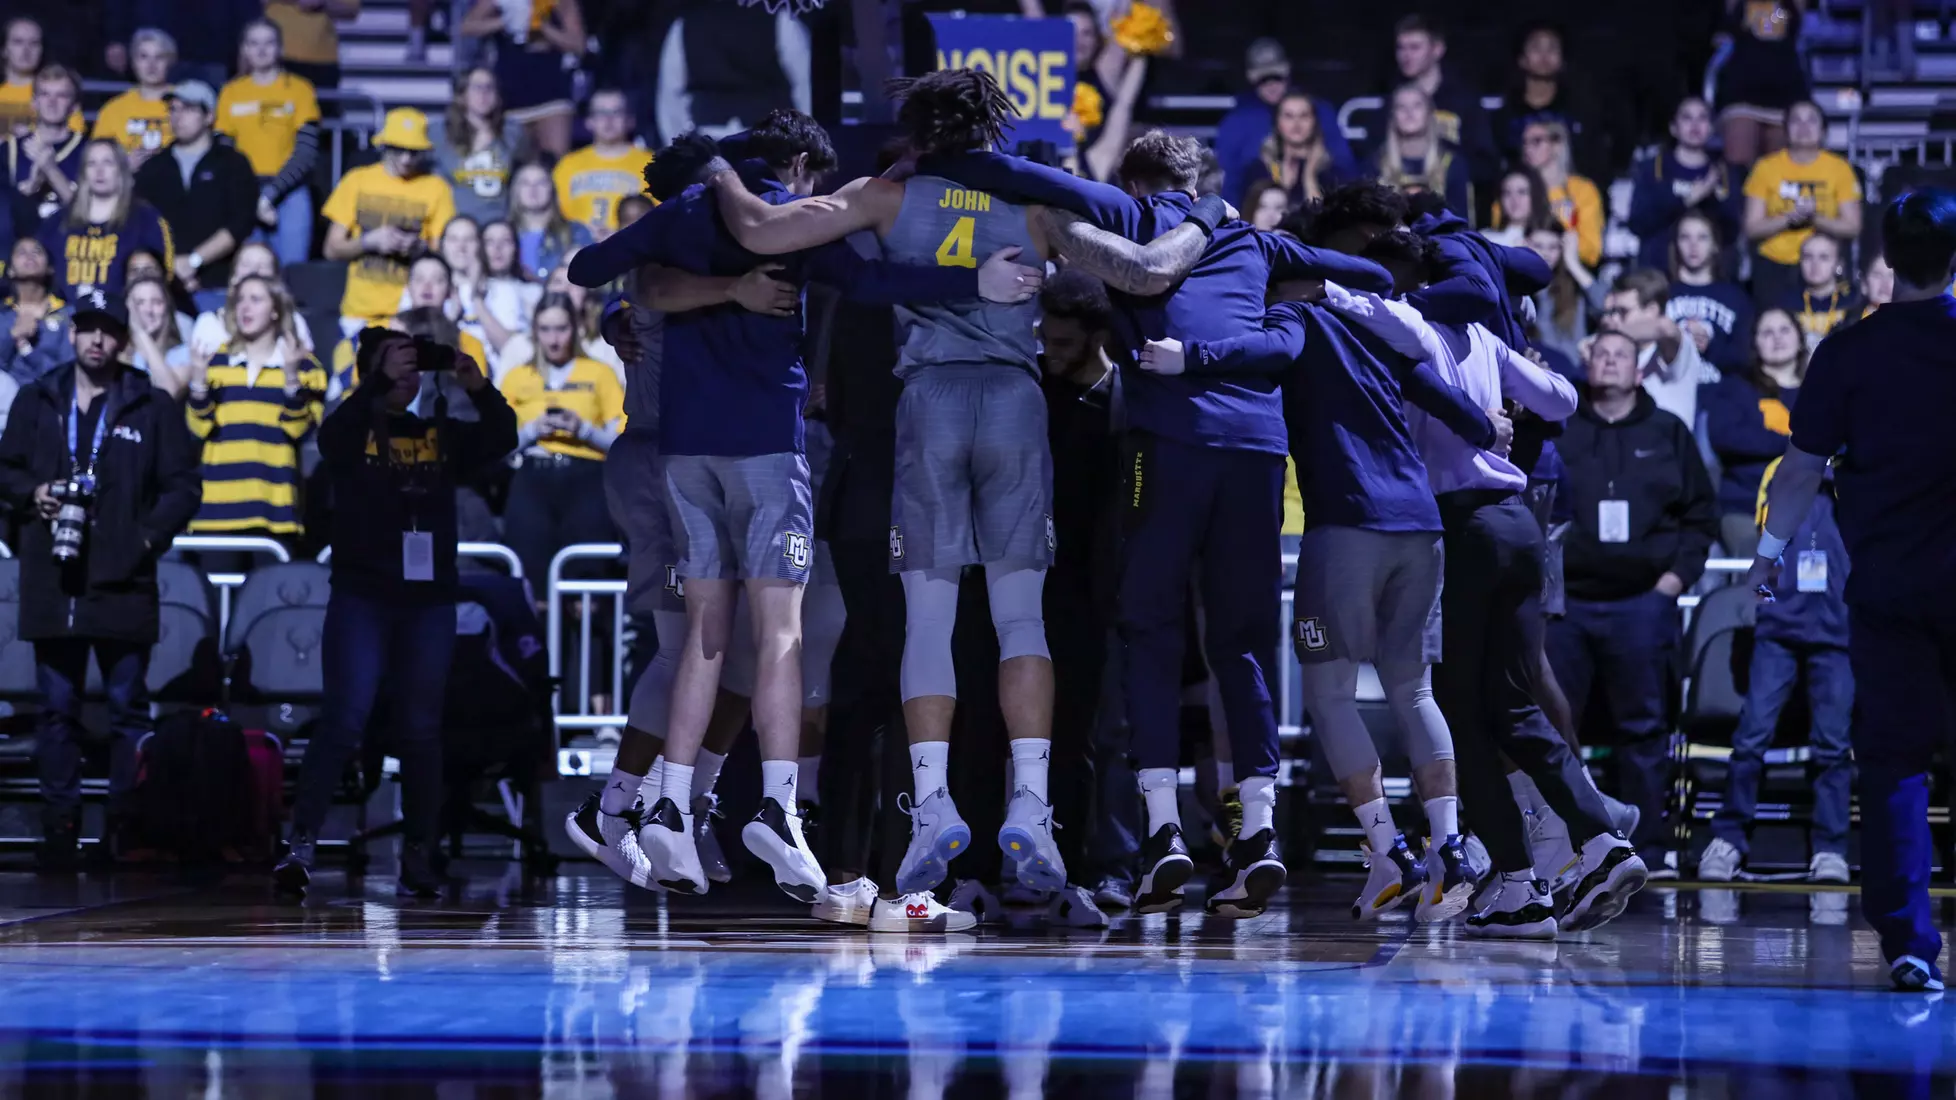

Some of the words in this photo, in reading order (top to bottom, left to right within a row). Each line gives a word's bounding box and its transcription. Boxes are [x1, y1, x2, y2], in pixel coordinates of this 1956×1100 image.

[939, 188, 991, 212] JOHN
[935, 216, 977, 268] 4
[1133, 452, 1143, 507] MARQUETTE
[784, 531, 809, 570] MU
[1297, 616, 1329, 651] MU
[280, 702, 294, 723] 2
